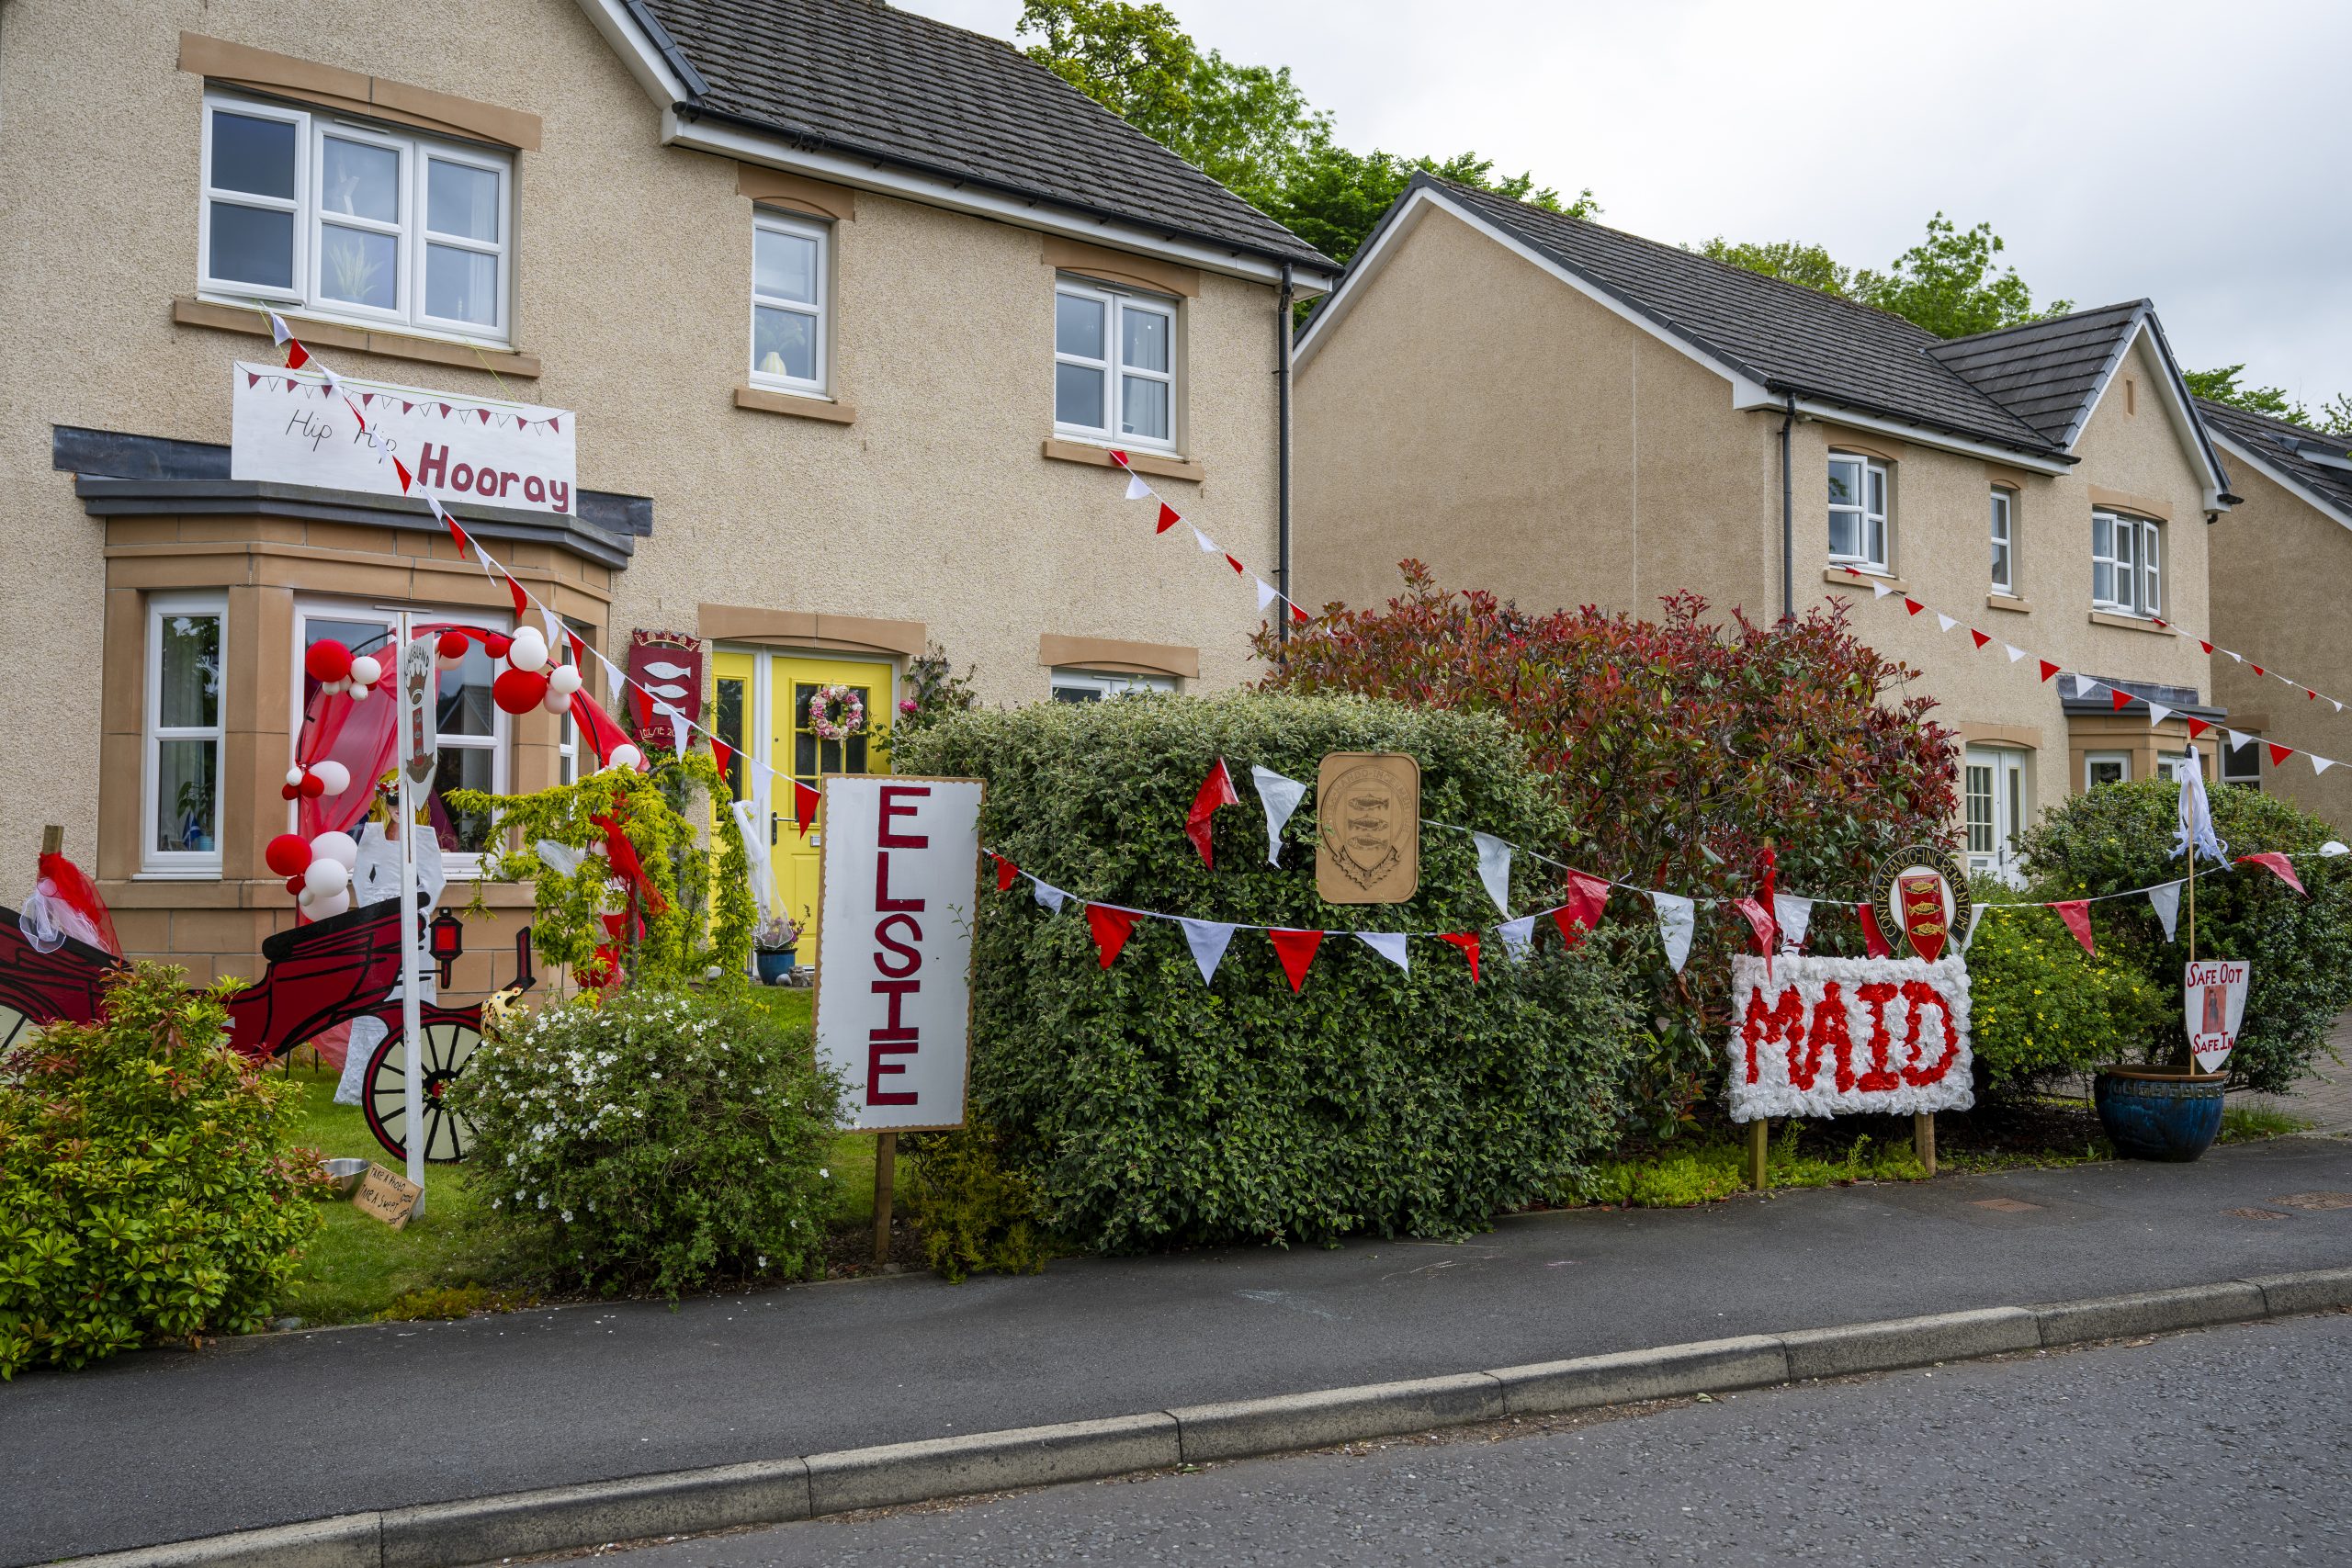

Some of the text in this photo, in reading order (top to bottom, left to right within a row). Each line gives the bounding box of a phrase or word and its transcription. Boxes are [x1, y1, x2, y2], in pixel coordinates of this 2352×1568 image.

[285, 409, 333, 452] Hip
[417, 442, 569, 513] Hooray
[865, 785, 931, 1106] ELSIE
[1741, 980, 1960, 1093] MAID
[371, 1191, 379, 1204] A
[383, 1174, 390, 1182] A
